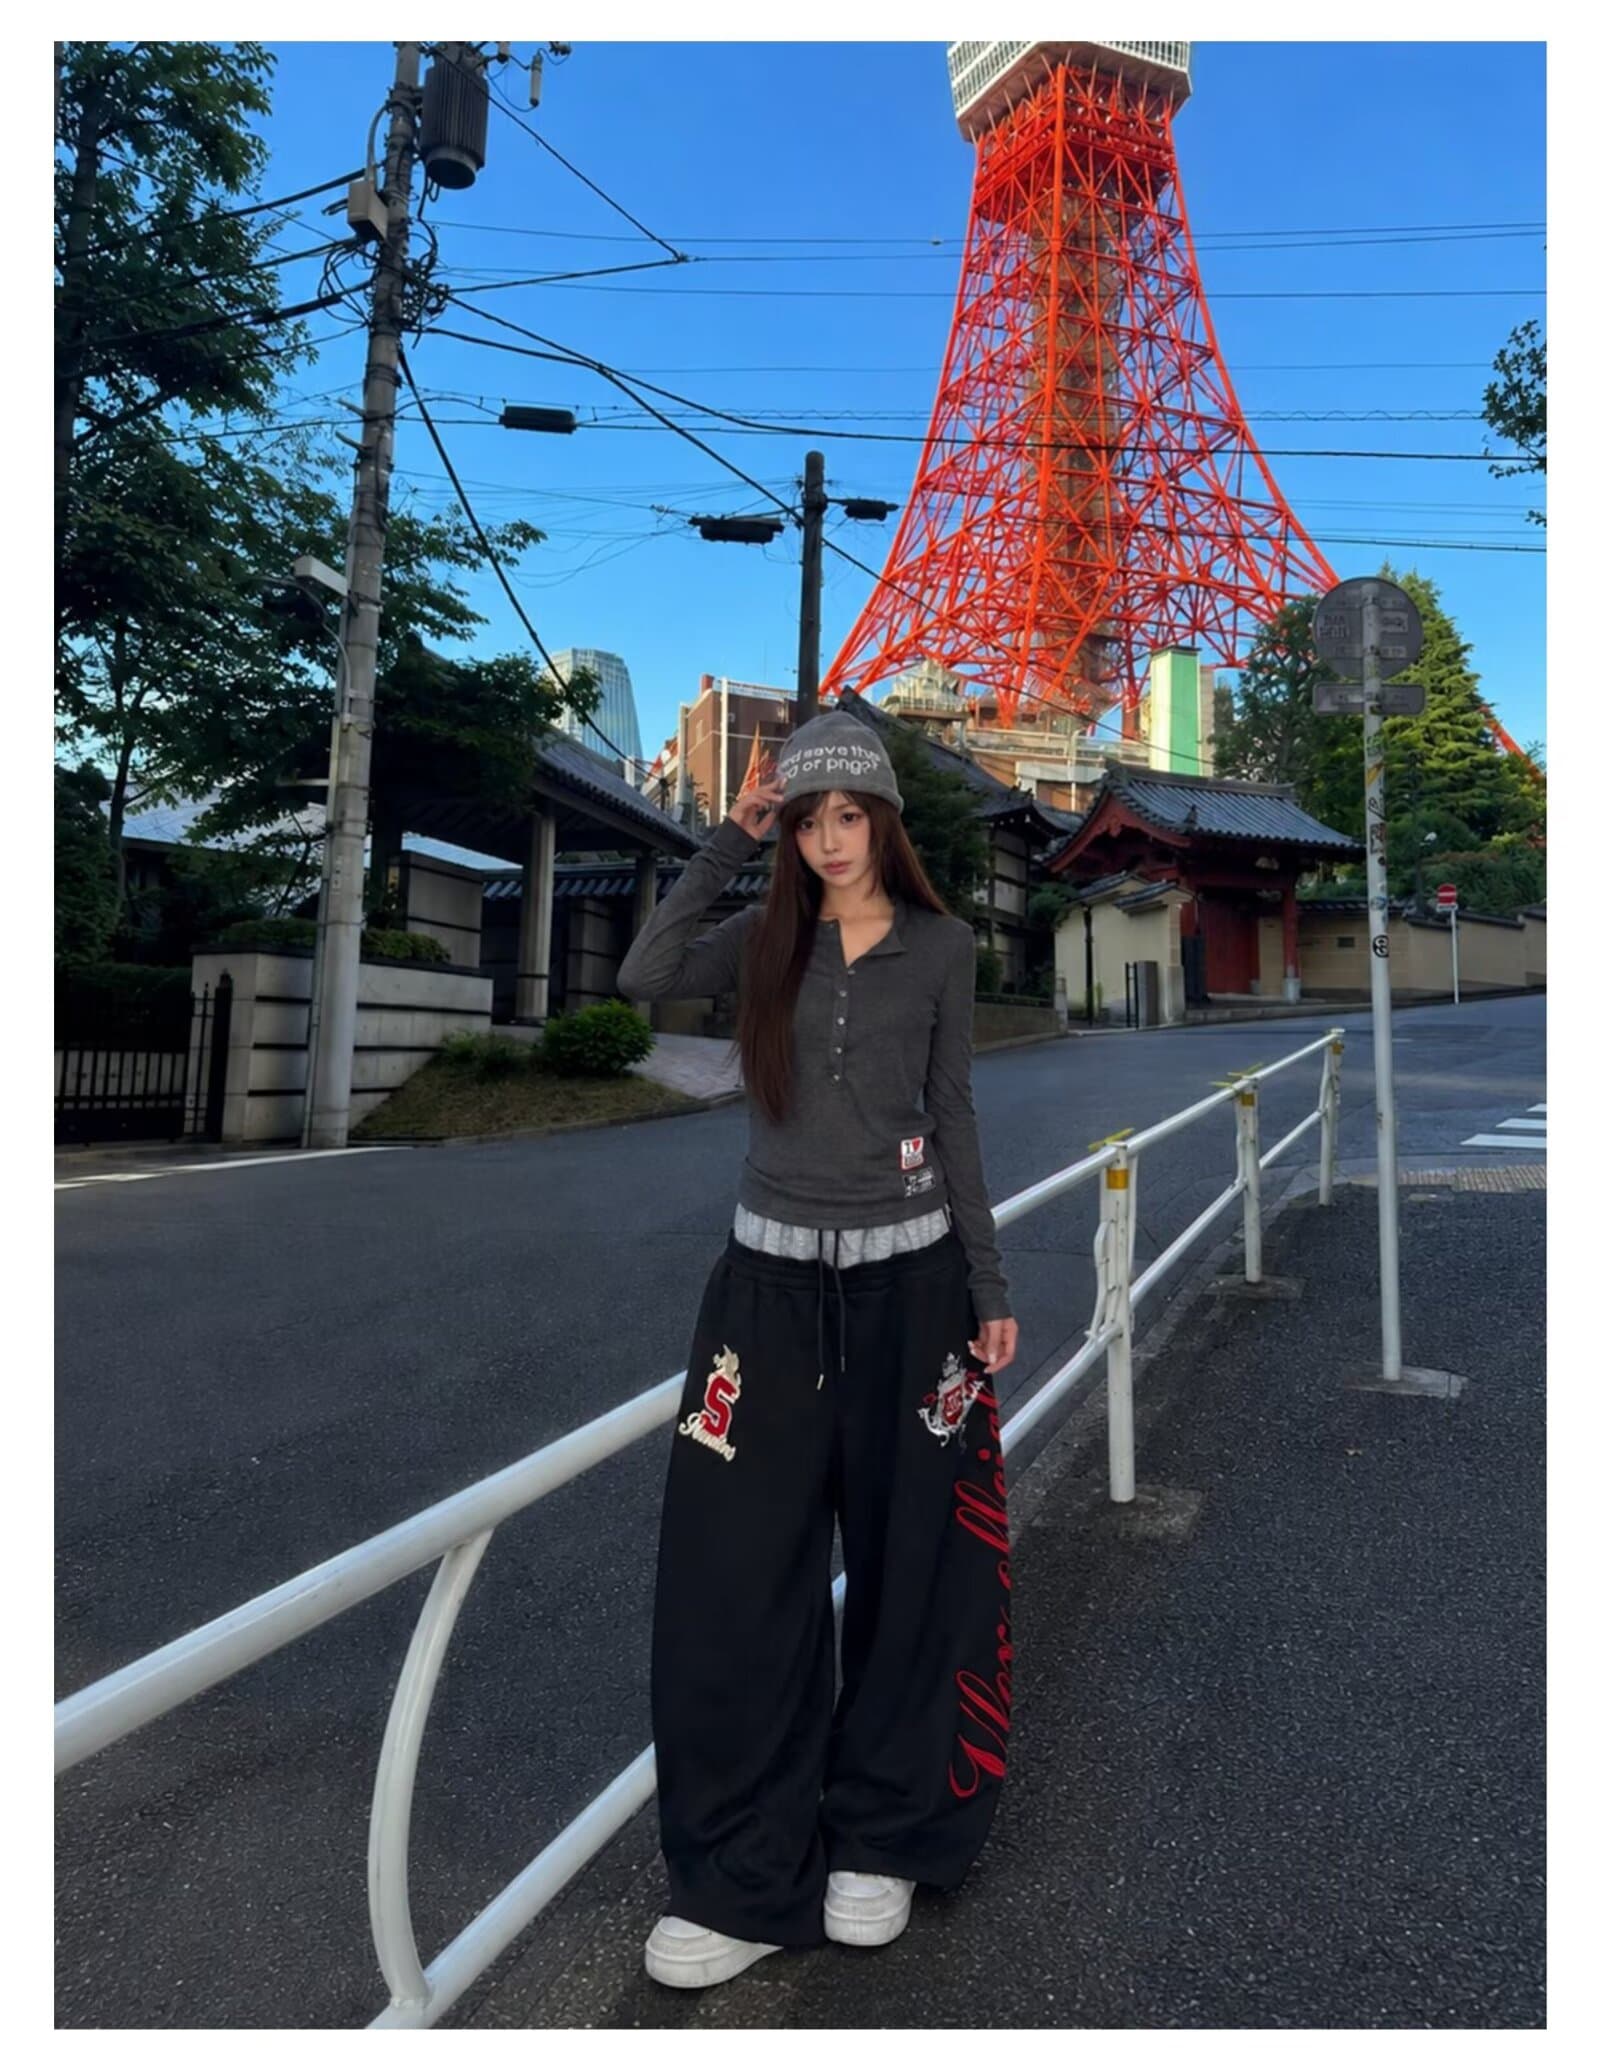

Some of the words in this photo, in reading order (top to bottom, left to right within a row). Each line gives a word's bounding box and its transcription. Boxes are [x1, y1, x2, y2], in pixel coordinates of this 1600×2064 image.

[803, 745, 848, 758] save
[802, 758, 822, 772] or
[704, 1373, 740, 1439] S
